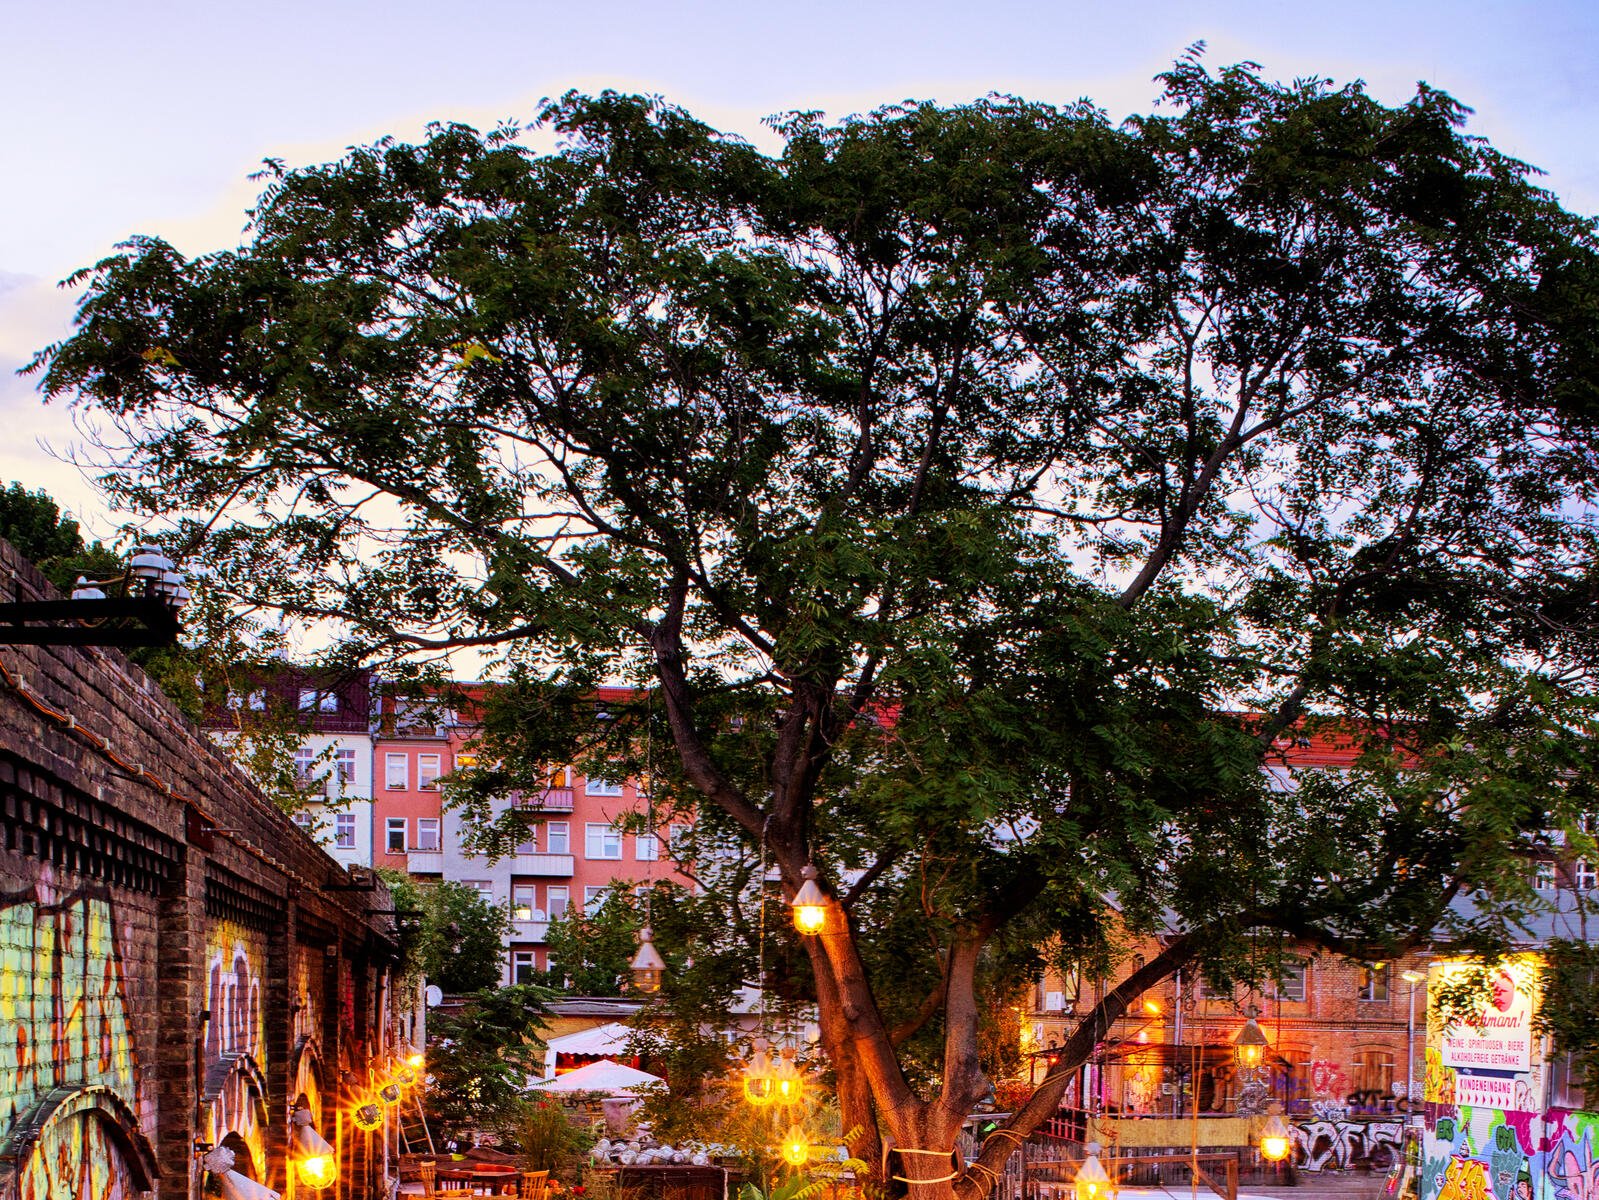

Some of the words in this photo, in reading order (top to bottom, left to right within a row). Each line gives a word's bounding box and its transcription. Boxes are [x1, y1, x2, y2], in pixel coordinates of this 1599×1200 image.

[1507, 1040, 1525, 1051] BIERE
[1451, 1052, 1489, 1063] ALKOHOLFREIE
[1491, 1053, 1520, 1065] GETRÄNKE
[1459, 1079, 1511, 1094] KUNDENEINGANG
